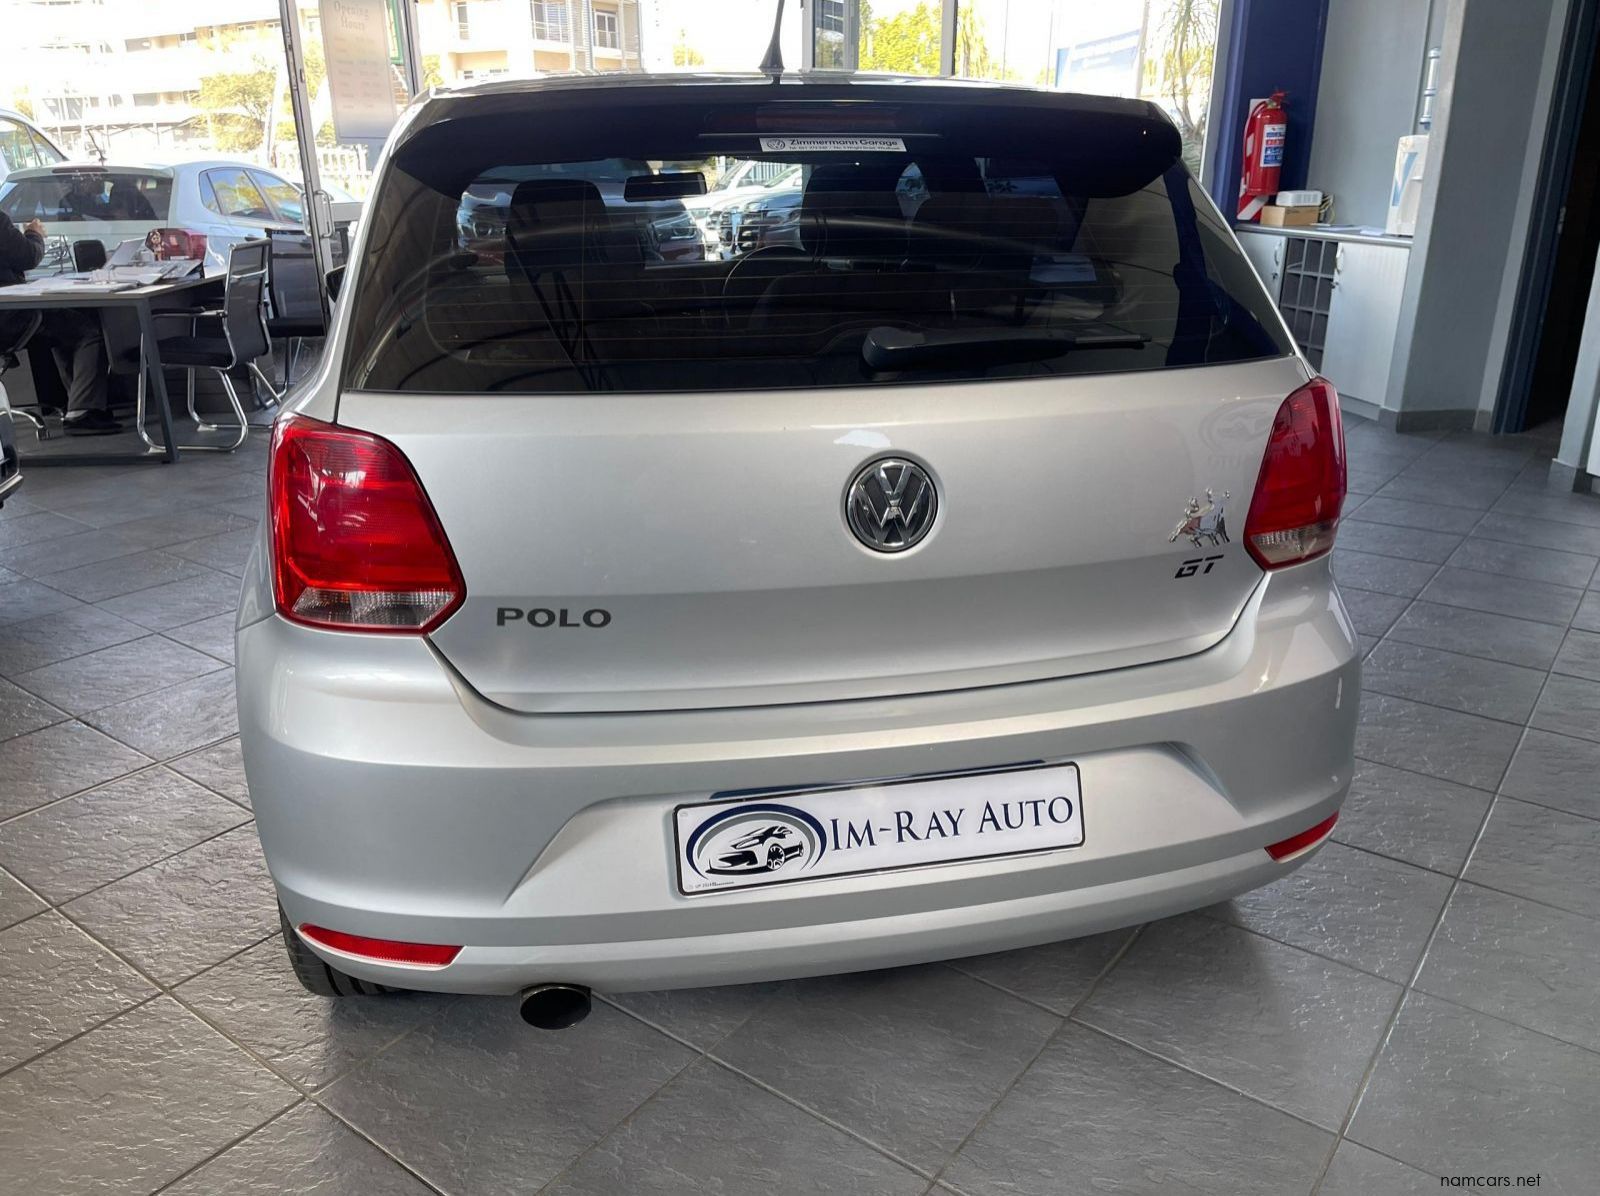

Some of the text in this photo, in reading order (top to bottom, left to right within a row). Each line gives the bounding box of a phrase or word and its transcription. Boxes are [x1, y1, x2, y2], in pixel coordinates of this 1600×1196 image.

[789, 138, 898, 147] Zimmermann Garage
[1174, 554, 1225, 579] GT
[496, 607, 612, 628] POLO
[977, 796, 1073, 834] AUTO
